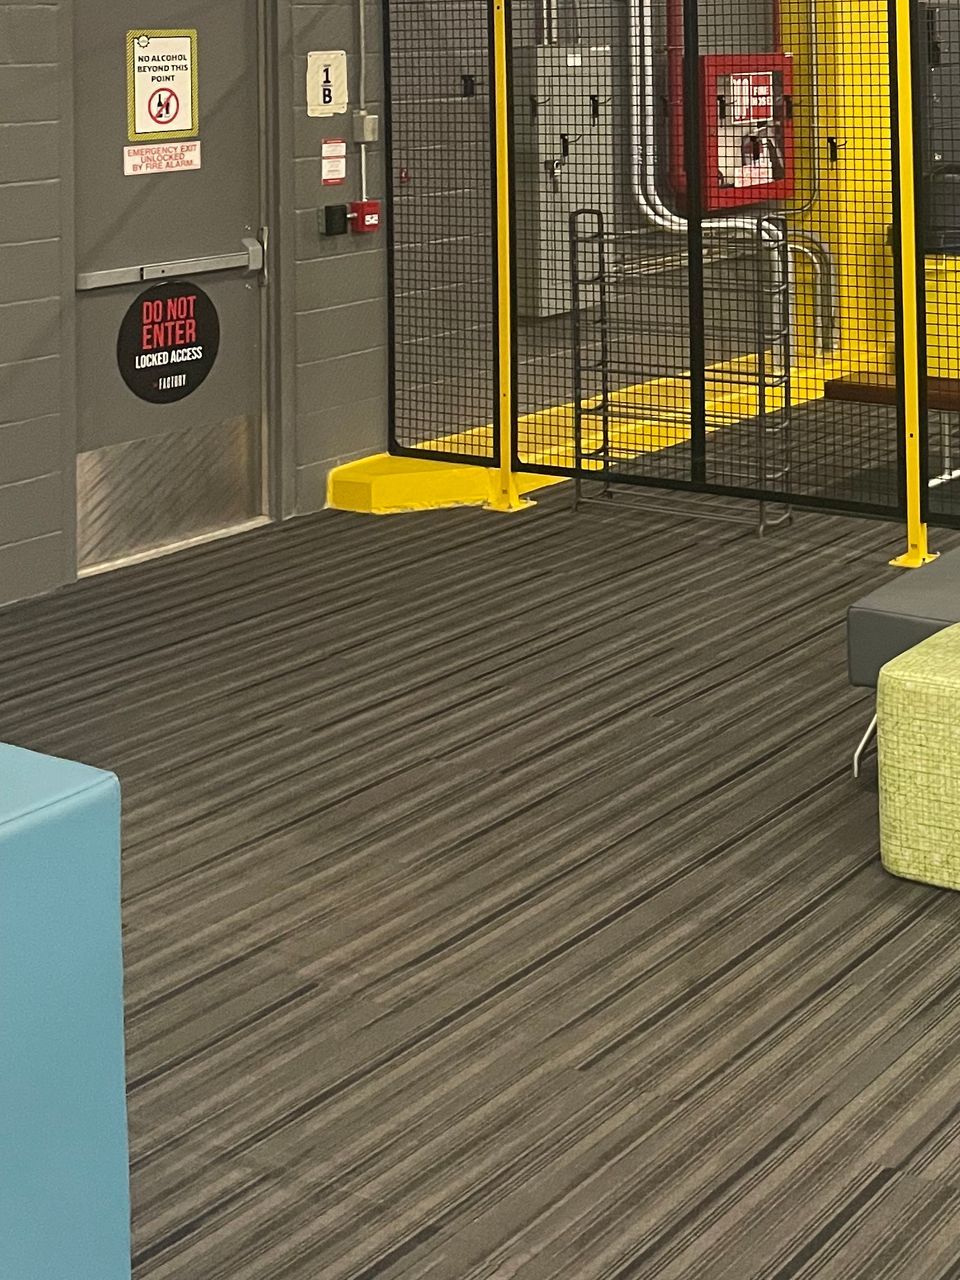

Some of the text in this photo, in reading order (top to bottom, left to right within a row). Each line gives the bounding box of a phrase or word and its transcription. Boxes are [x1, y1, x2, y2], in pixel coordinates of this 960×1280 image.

[151, 54, 187, 62] ALCOHOL
[137, 65, 170, 73] BEYOND
[322, 67, 331, 84] 1
[322, 87, 332, 104] B
[127, 144, 197, 157] EMERGENCY EXIT
[140, 153, 185, 164] UNLOCKED
[132, 160, 193, 172] BY FIRE ALARM
[143, 295, 197, 324] DO NOT
[142, 319, 196, 349] ENTER
[135, 346, 203, 369] LOCKED ACCESS
[158, 374, 186, 390] FACTORY
